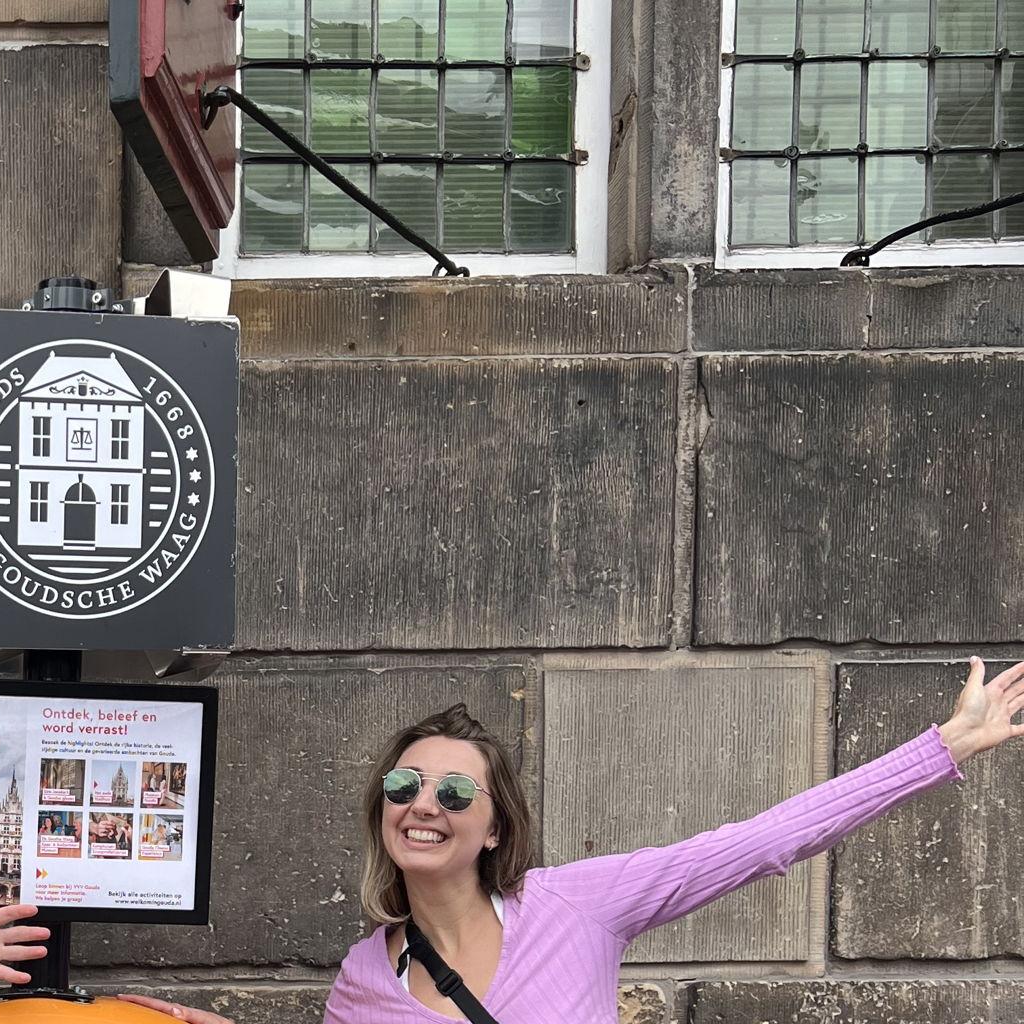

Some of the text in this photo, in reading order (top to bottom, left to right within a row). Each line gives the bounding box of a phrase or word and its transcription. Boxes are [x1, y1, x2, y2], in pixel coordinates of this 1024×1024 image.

[142, 376, 194, 440] 1668
[139, 512, 197, 585] WAAG
[42, 707, 157, 722] Ontdek, beleef en
[42, 721, 128, 736] word verrast!
